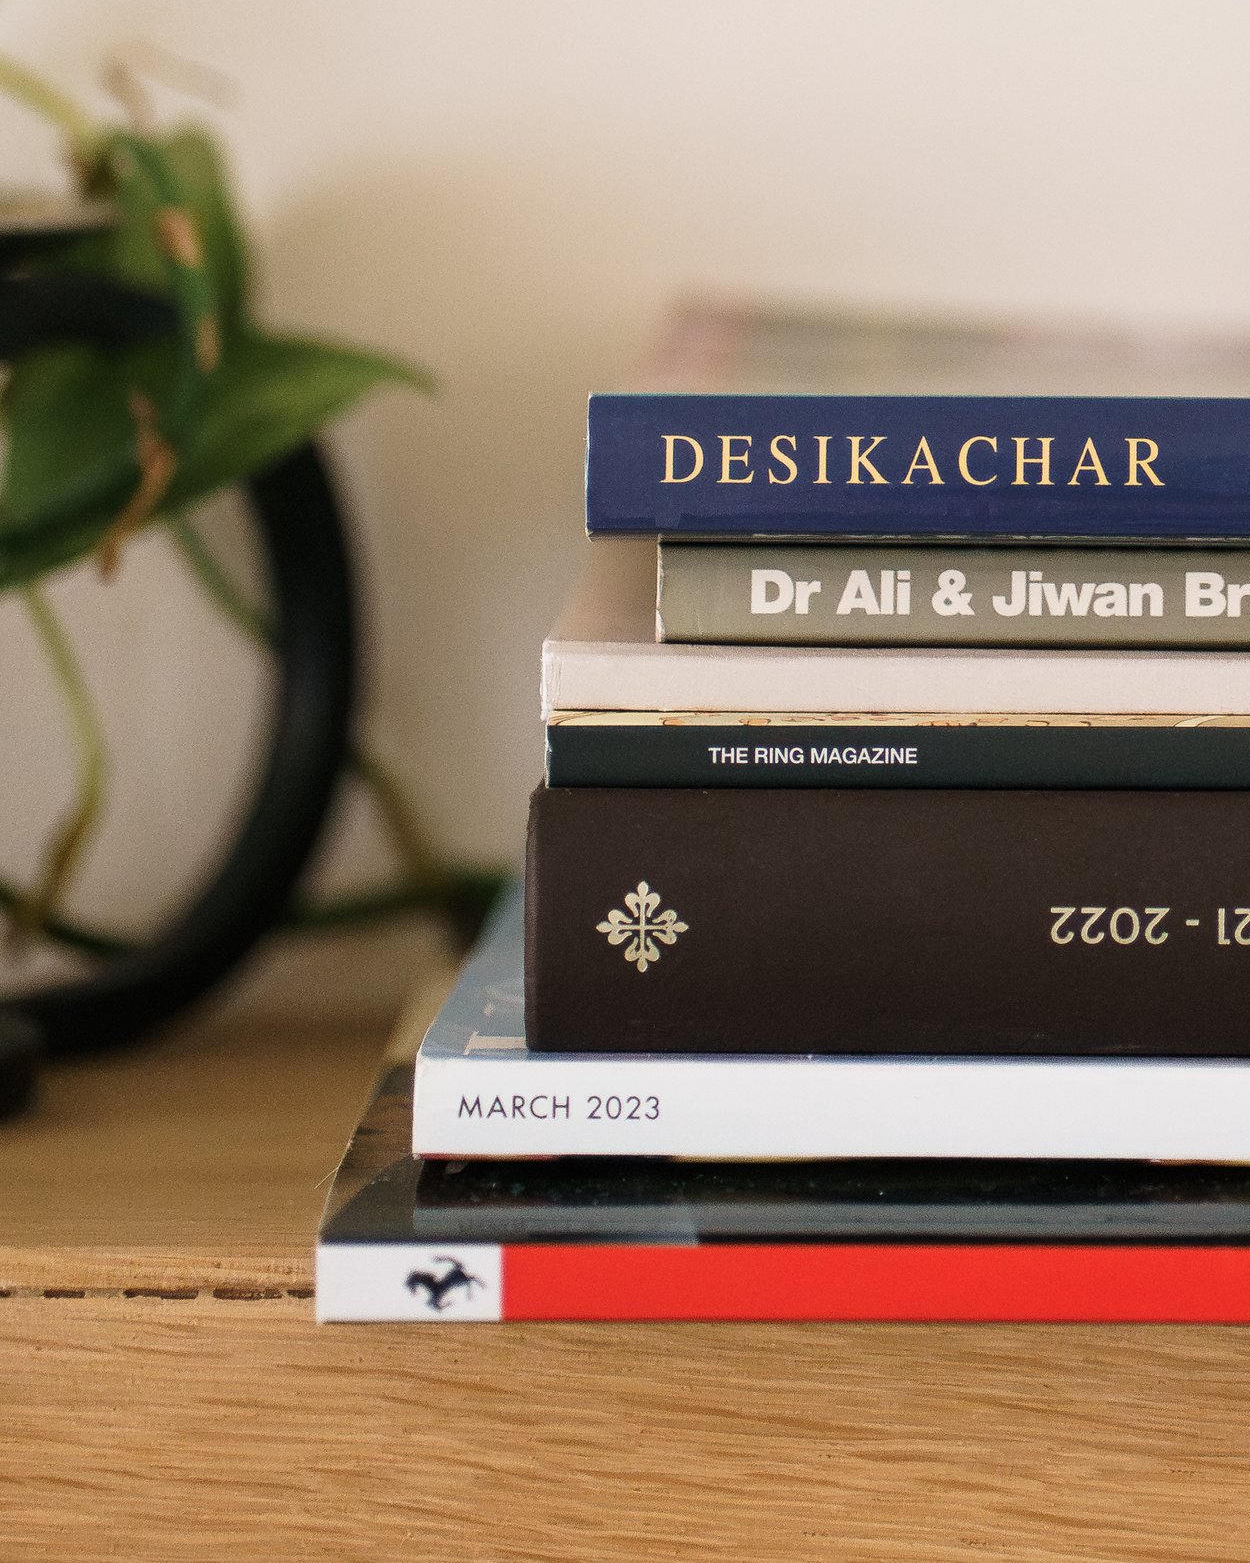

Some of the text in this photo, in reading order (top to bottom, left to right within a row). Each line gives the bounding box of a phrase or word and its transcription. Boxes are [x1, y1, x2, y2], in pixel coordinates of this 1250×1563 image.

[659, 434, 1167, 486] DESIKACHAR
[750, 569, 822, 615] Dr
[835, 569, 911, 616] Ali
[931, 569, 976, 617] &
[992, 570, 1164, 618] Jiwan
[707, 746, 918, 765] THE RING MAGAZINE
[1050, 906, 1170, 945] 2022
[457, 1095, 660, 1120] MARCH 2023
